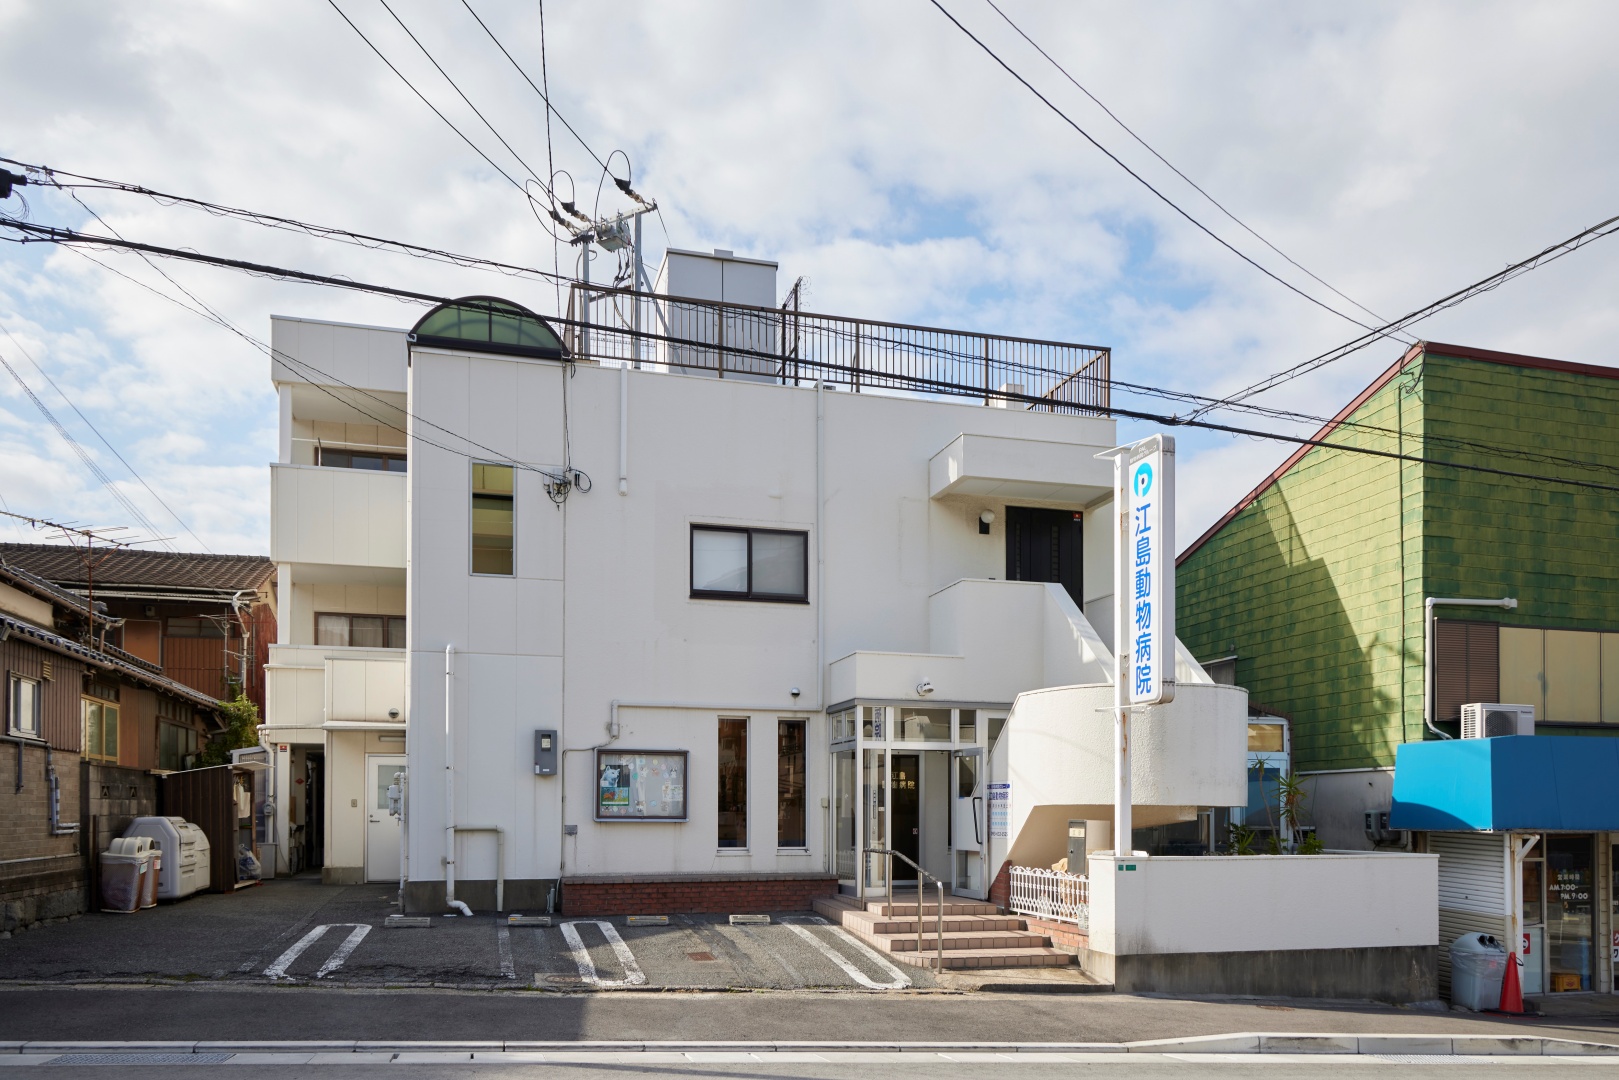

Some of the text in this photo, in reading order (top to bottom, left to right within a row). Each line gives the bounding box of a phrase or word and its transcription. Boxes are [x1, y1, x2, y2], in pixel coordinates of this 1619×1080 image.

[1135, 502, 1151, 696] 江島動物病院
